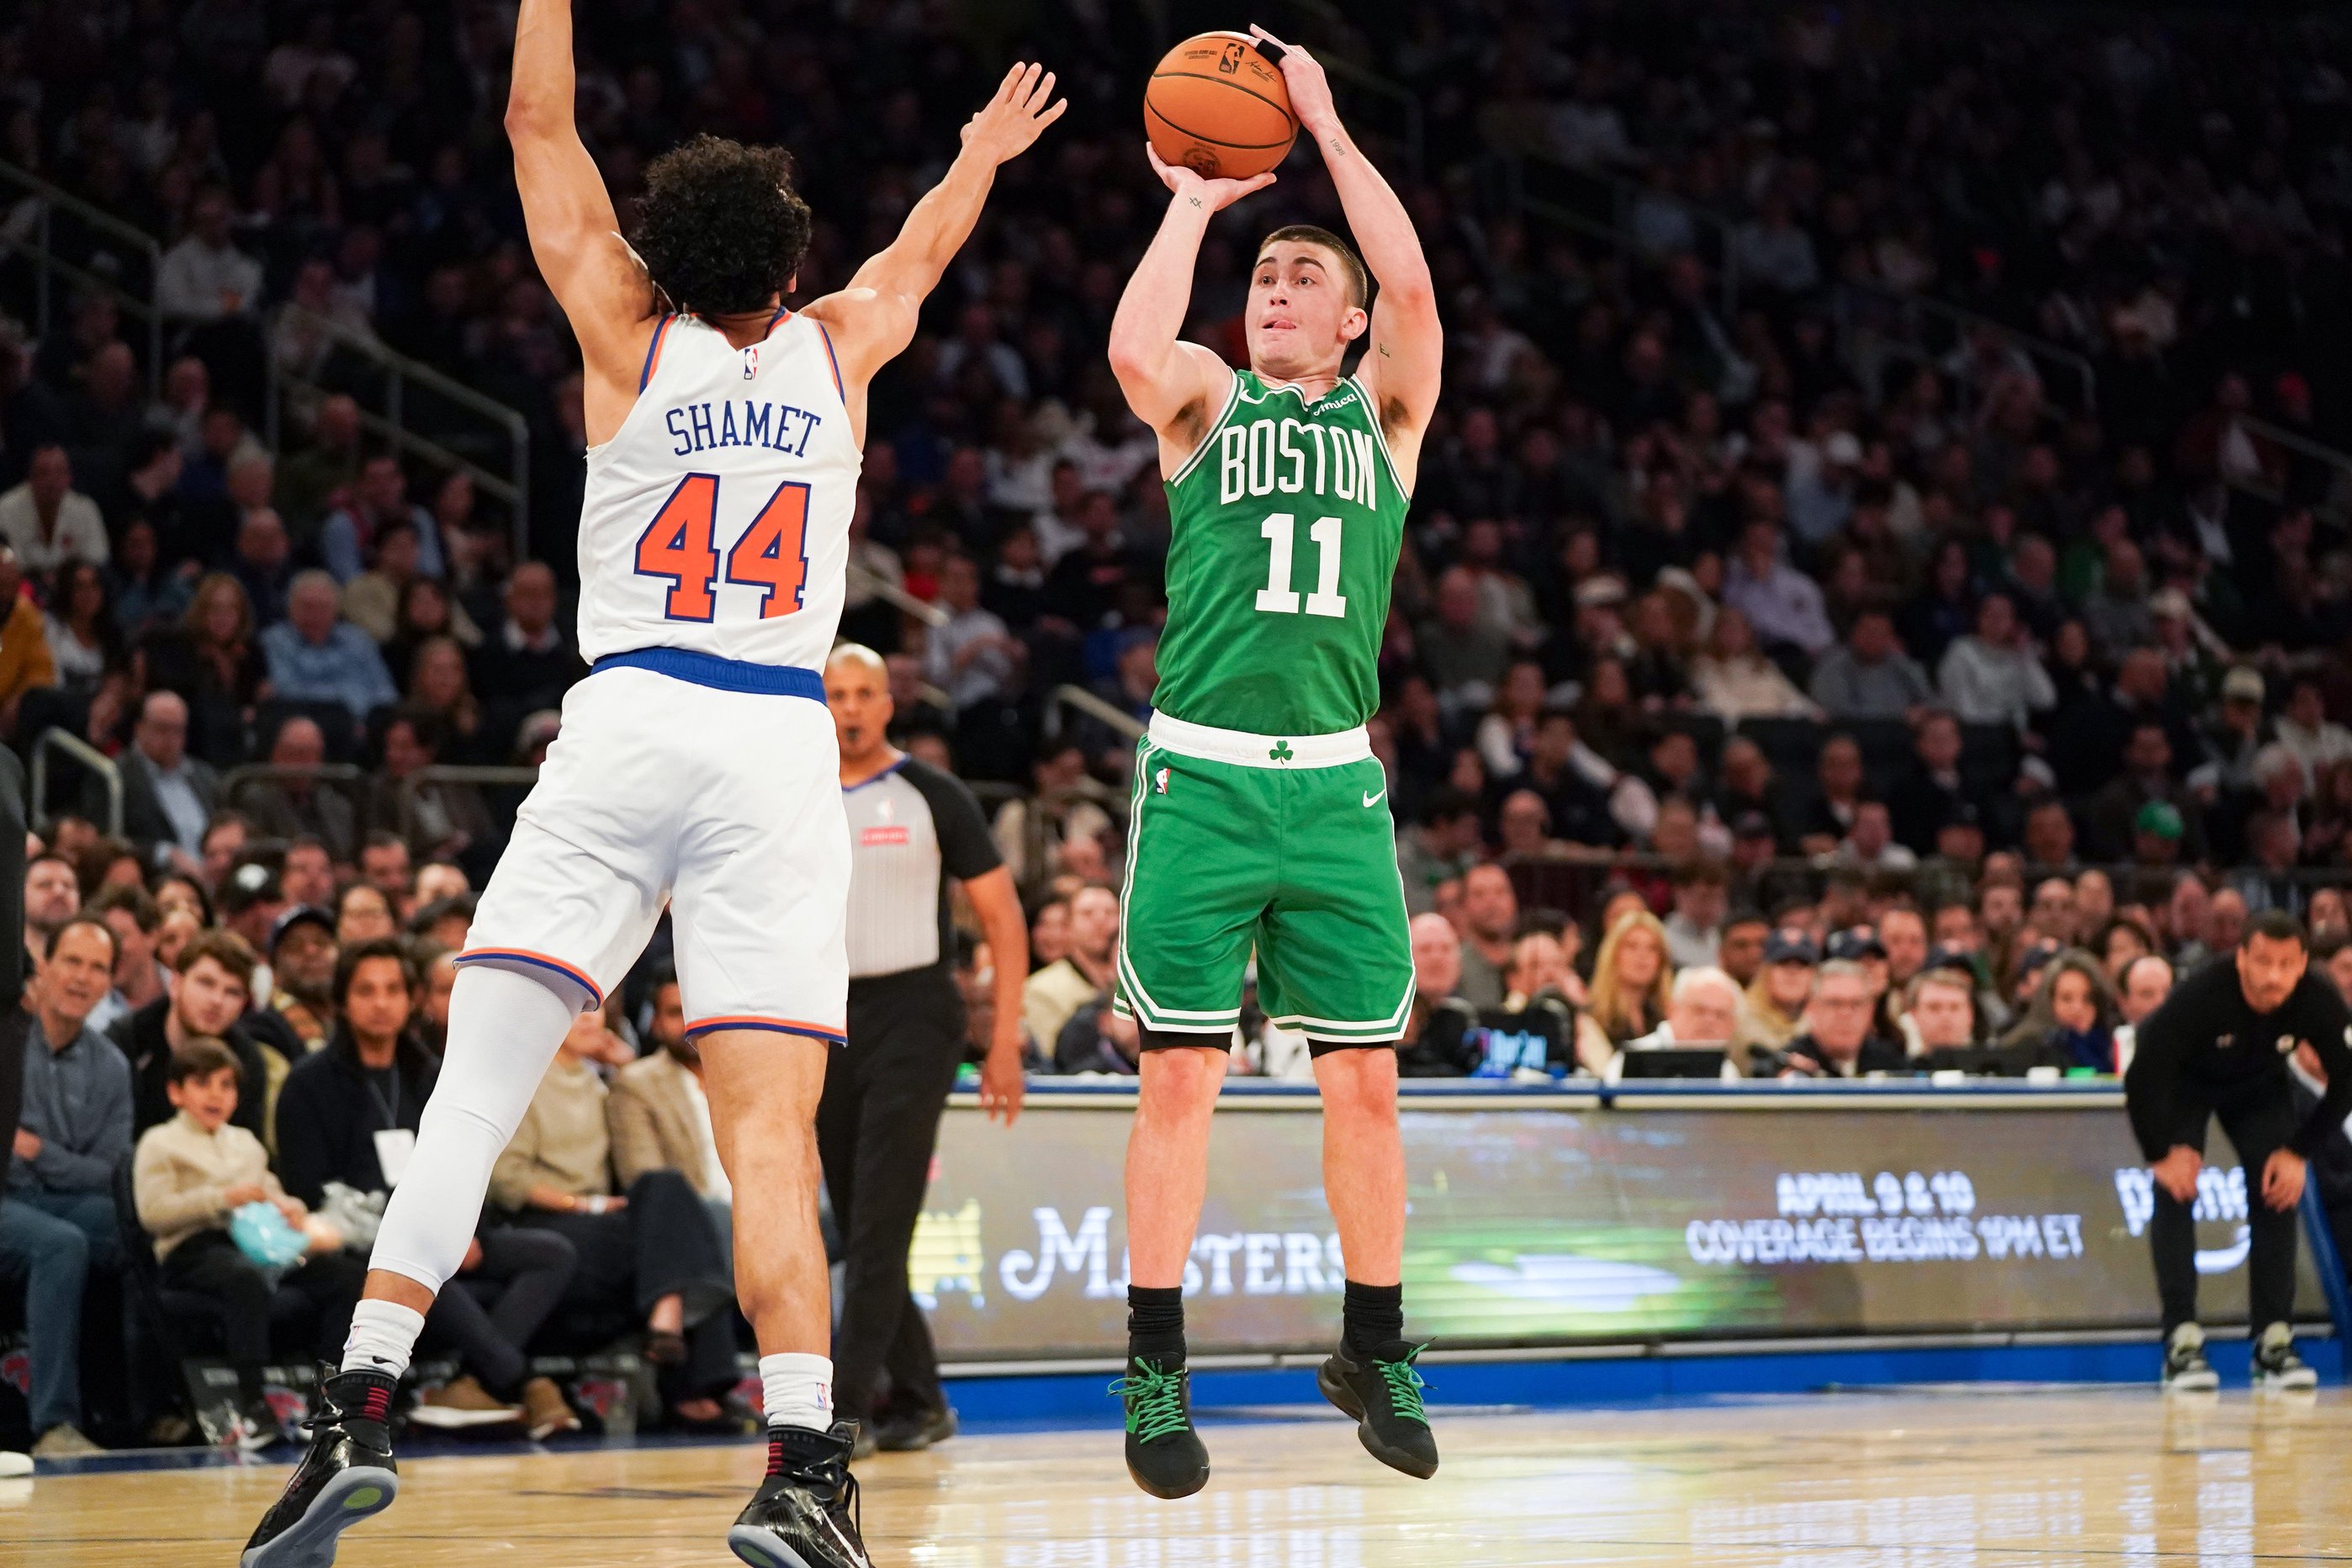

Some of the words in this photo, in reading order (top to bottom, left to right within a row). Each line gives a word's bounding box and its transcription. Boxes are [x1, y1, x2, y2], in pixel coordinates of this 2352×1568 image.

[1329, 138, 1346, 156] 1998
[665, 400, 821, 458] SHAMET
[1313, 393, 1358, 416] Amica
[1221, 418, 1375, 511] BOSTON
[633, 472, 812, 623] 44
[1255, 513, 1346, 617] 11
[1776, 1172, 1878, 1217] APRIL
[1686, 1218, 1864, 1263] COVERAGE
[1860, 1216, 1979, 1262] BEGINS
[2041, 1214, 2084, 1260] ET
